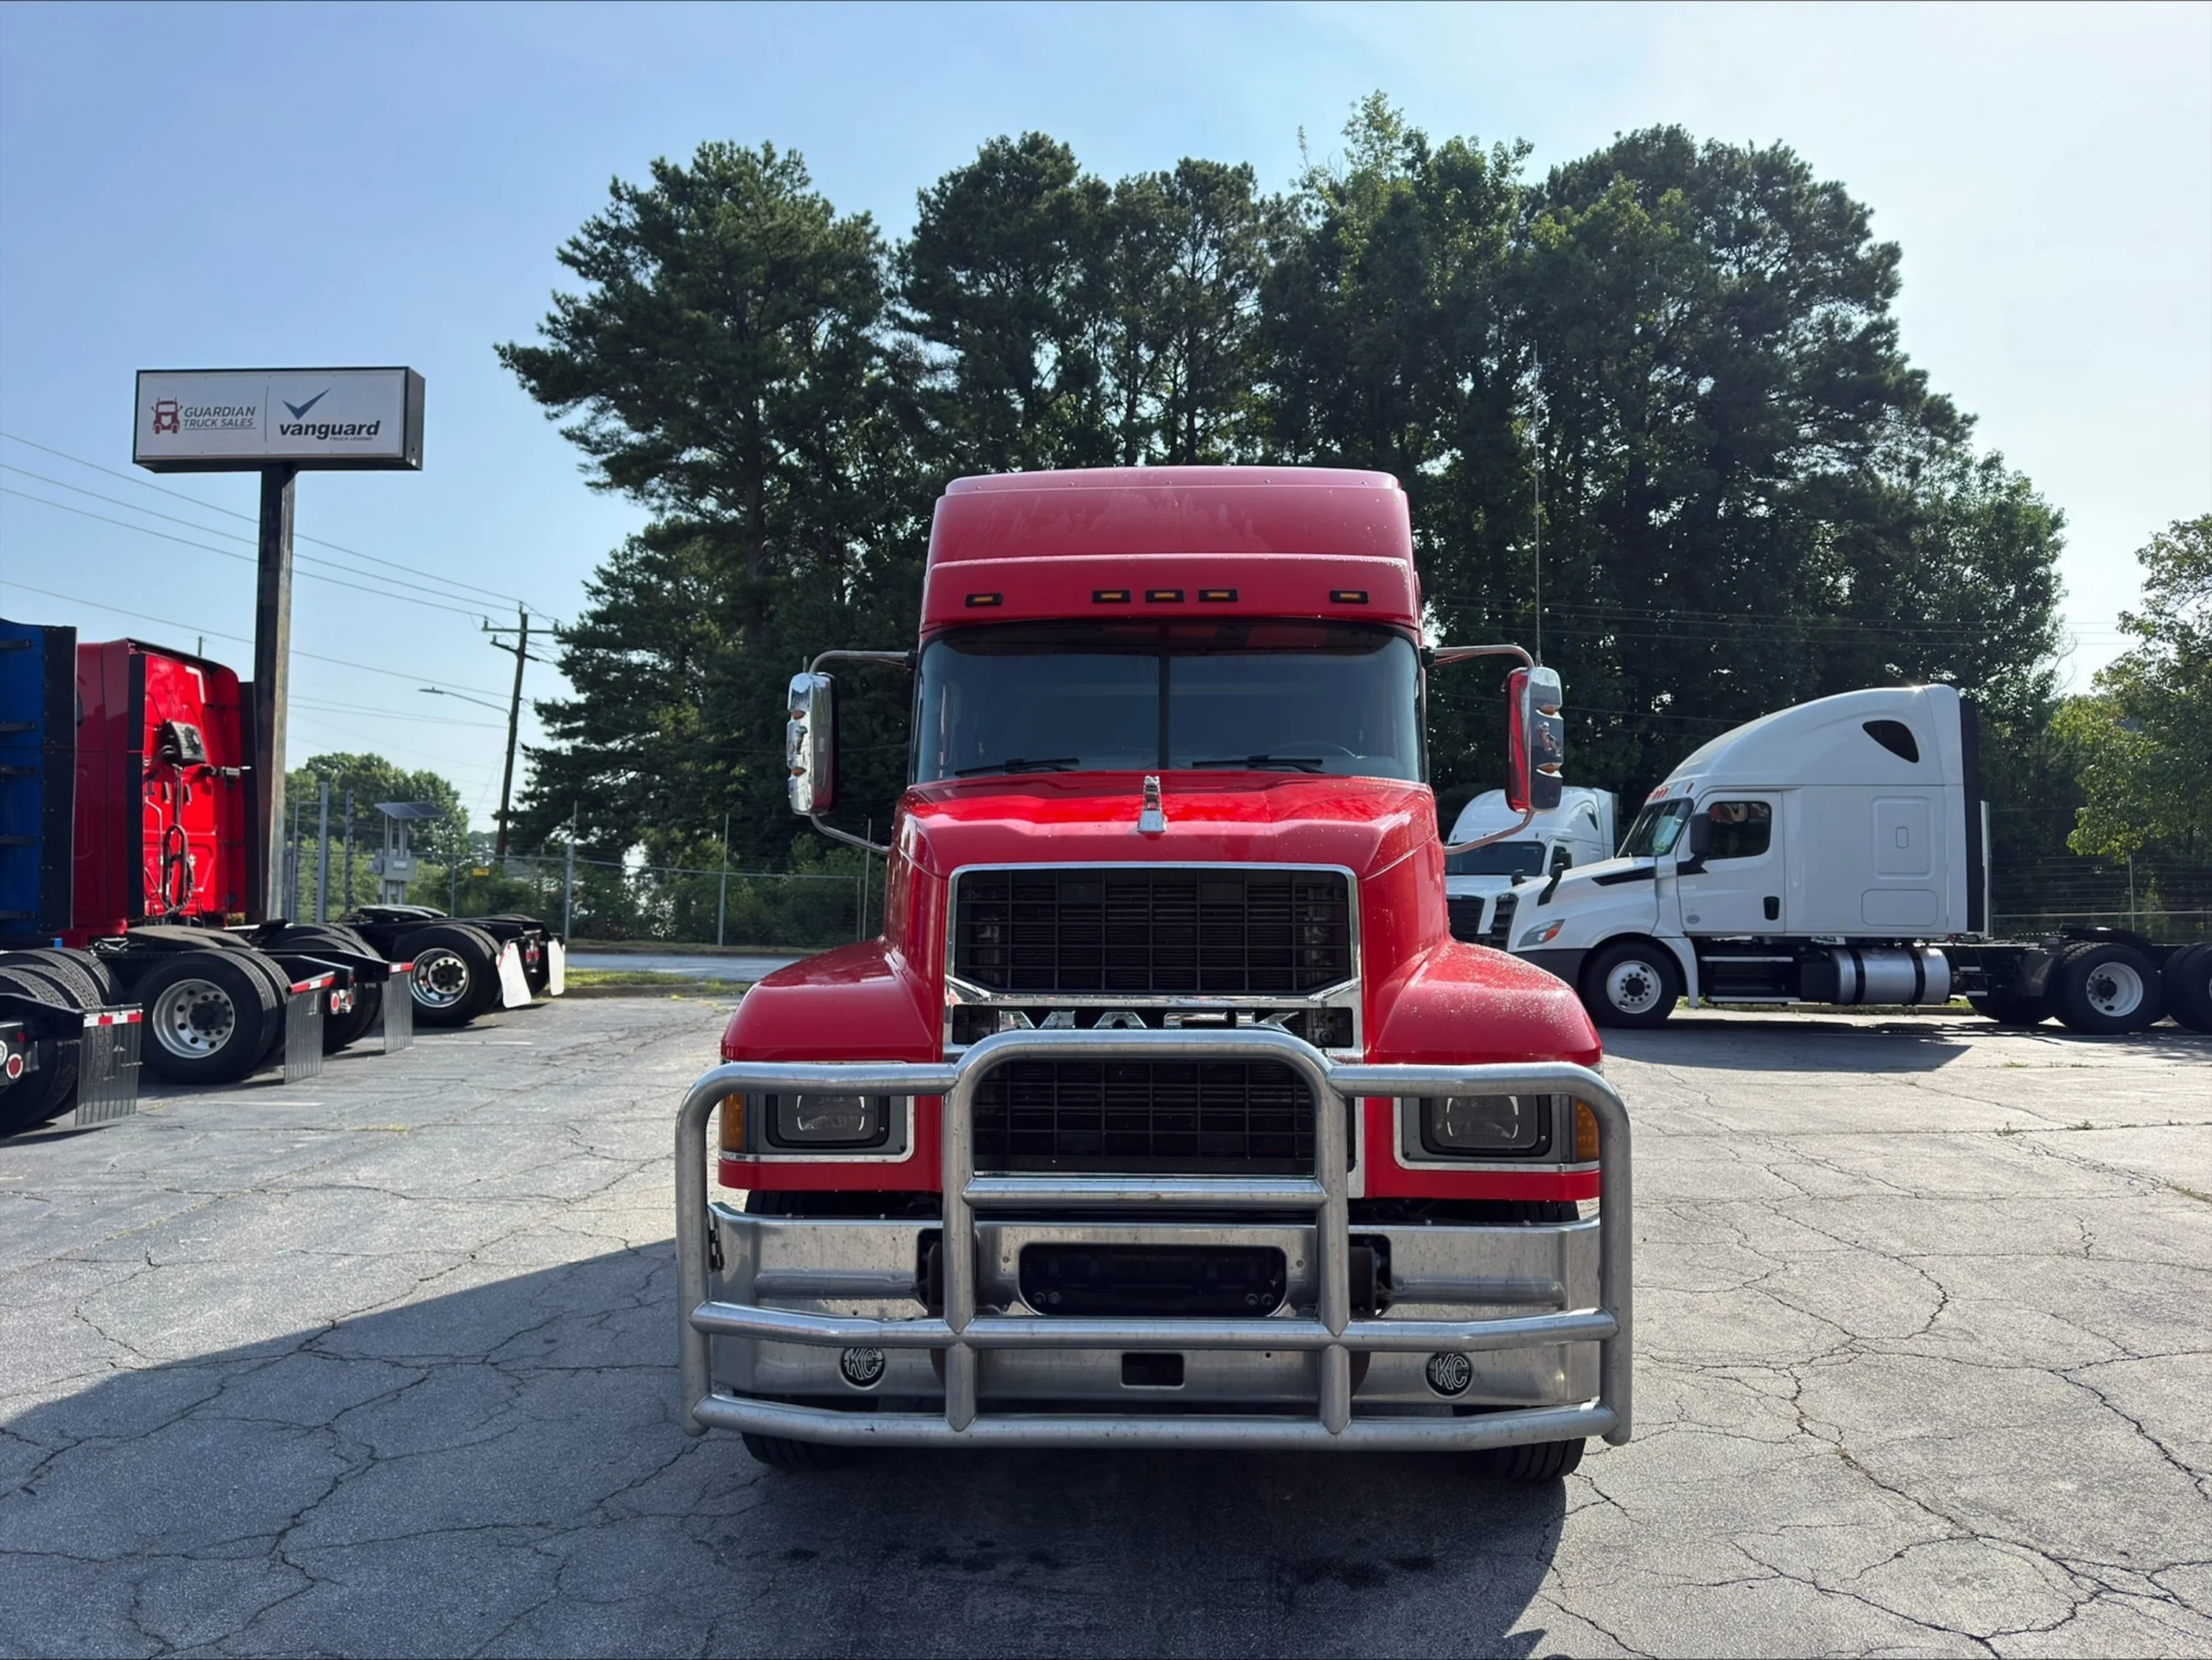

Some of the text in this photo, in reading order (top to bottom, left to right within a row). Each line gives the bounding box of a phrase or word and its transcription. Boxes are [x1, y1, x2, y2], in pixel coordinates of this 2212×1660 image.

[184, 406, 256, 417] GUARDIAN
[184, 418, 254, 428] TRUCK SALES
[279, 420, 380, 440] vanguard
[1436, 1353, 1467, 1389] KC
